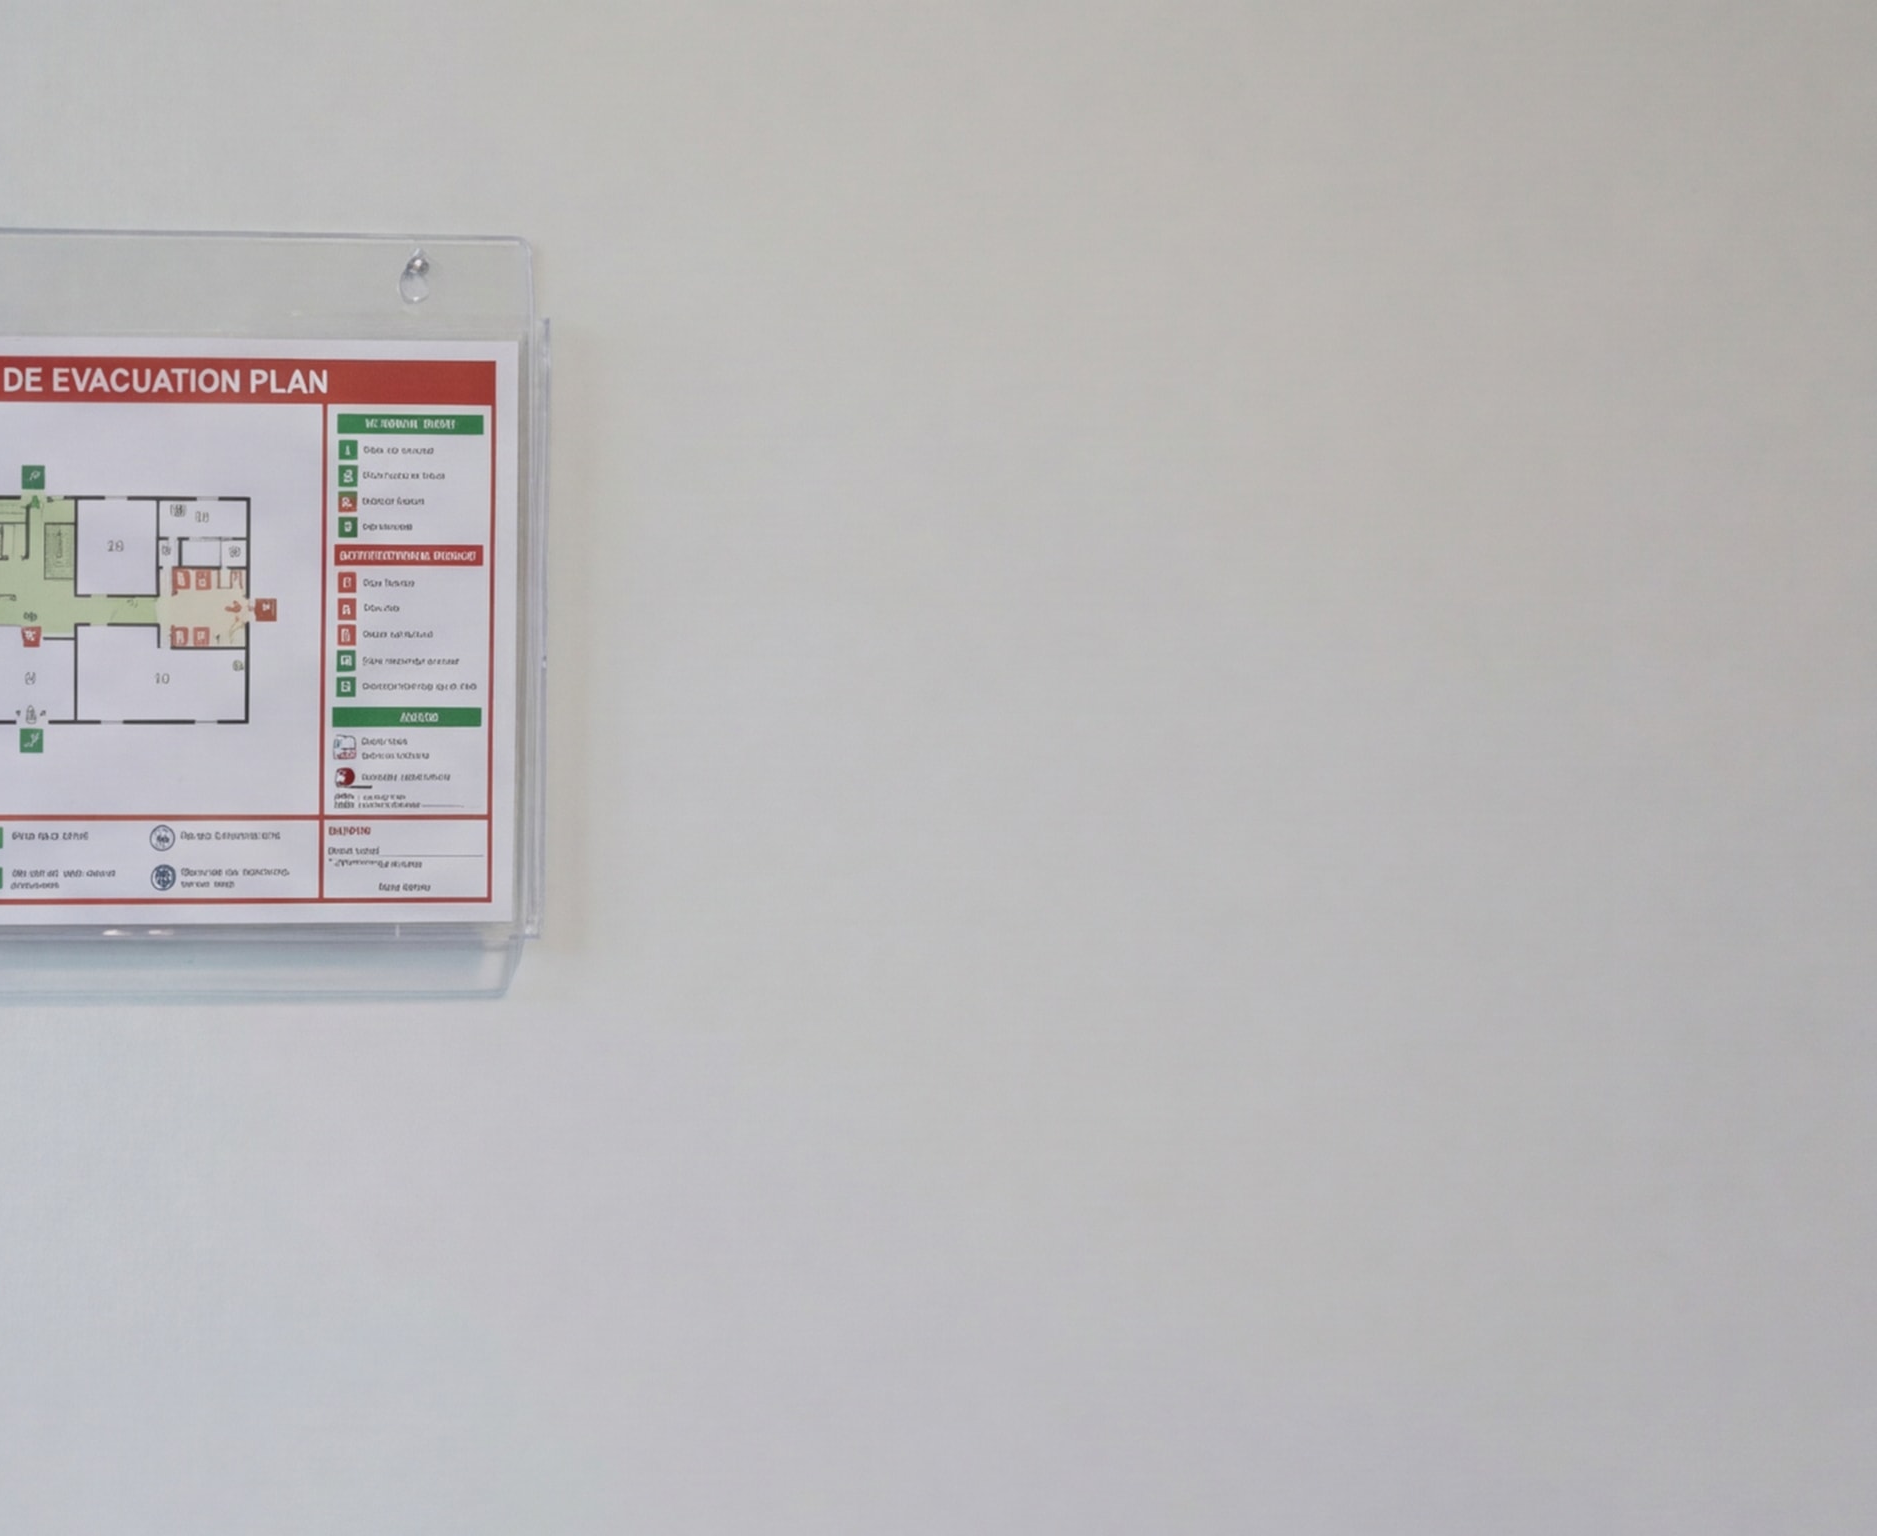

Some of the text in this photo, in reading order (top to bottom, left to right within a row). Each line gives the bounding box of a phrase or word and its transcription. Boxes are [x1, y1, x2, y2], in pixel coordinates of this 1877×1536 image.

[3, 368, 43, 392] DE
[52, 368, 240, 394] EVACUATION
[250, 369, 328, 394] PLAN
